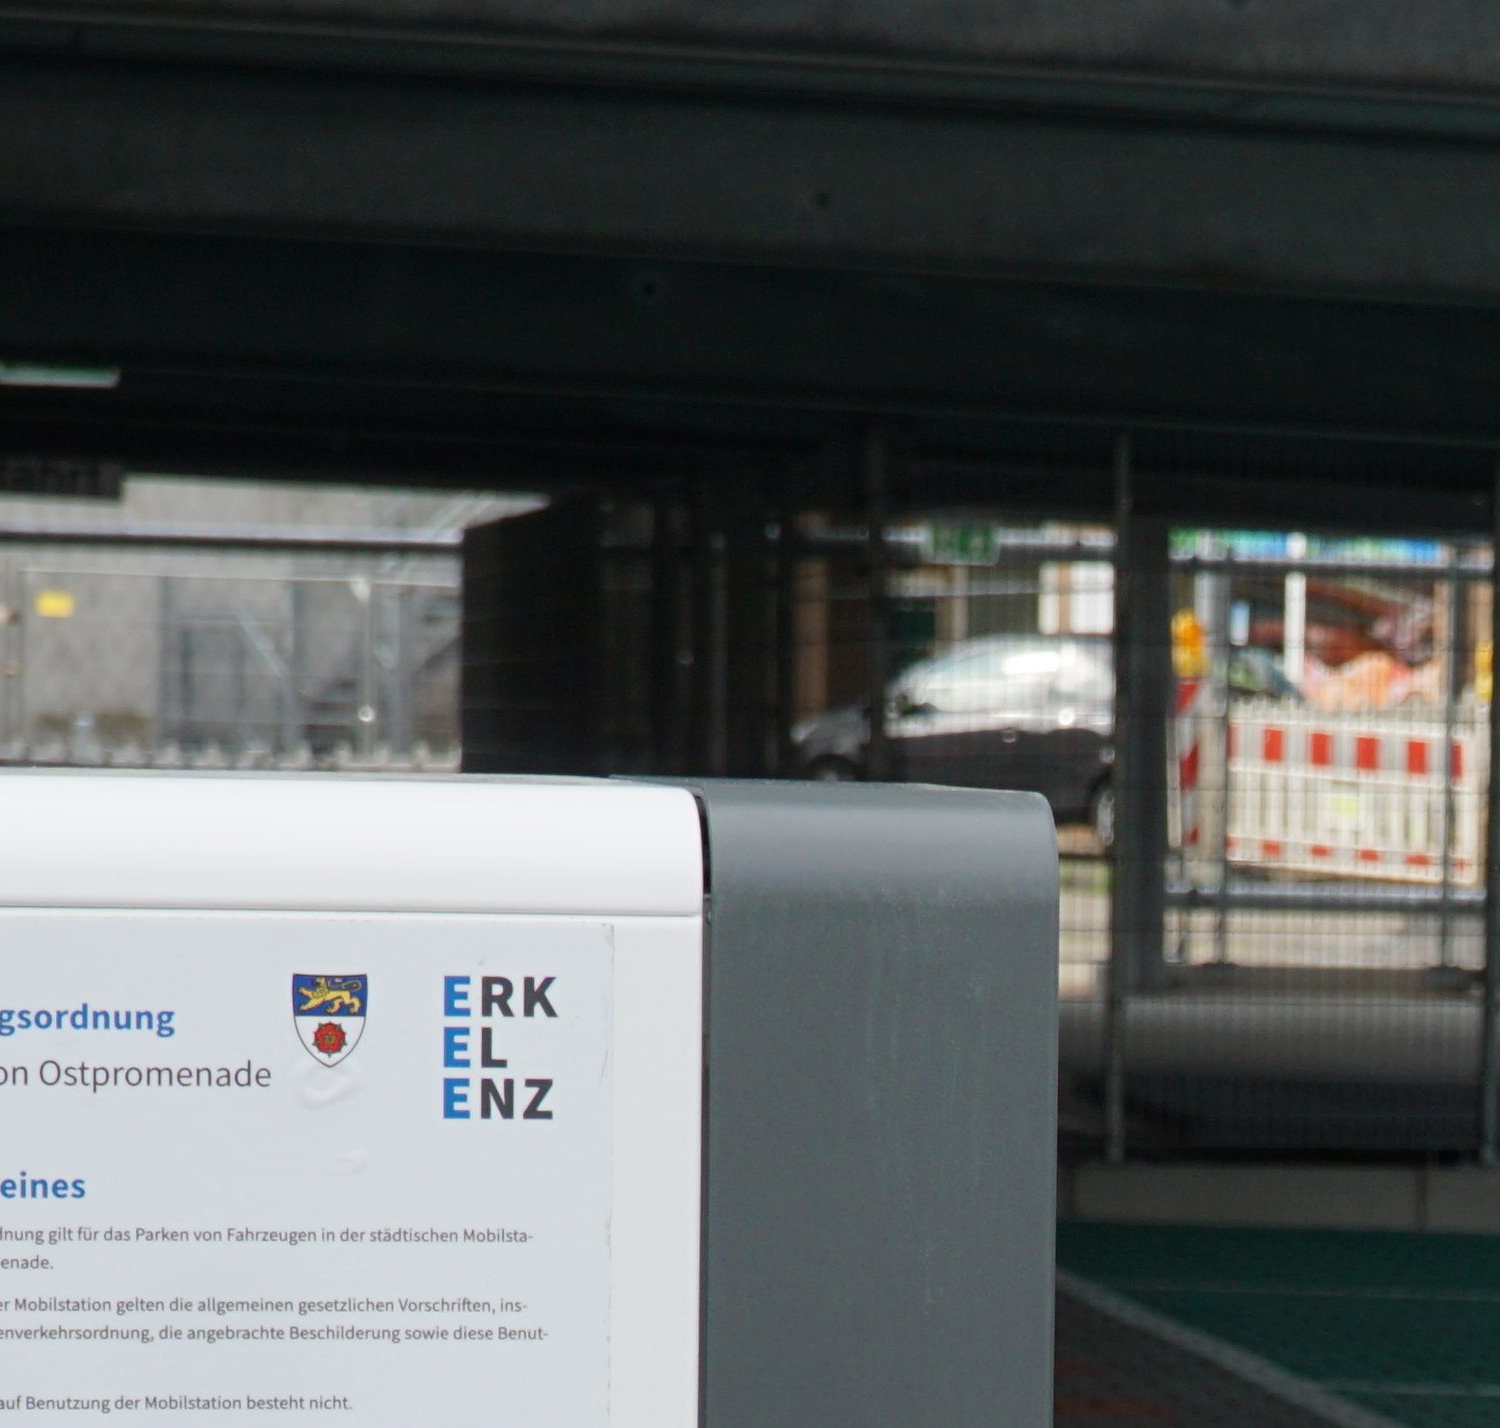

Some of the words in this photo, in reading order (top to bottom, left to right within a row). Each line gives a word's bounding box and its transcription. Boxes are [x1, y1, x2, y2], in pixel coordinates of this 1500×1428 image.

[444, 977, 557, 1019] ERK
[443, 1027, 508, 1070] EL
[38, 1060, 271, 1094] Ostpromenade
[443, 1078, 553, 1121] ENZ
[47, 1226, 73, 1246] gilt
[77, 1226, 100, 1242] für
[103, 1226, 131, 1242] das
[135, 1226, 189, 1242] Parken
[193, 1230, 222, 1242] von
[227, 1226, 316, 1246] Fahrzeugen
[321, 1227, 335, 1242] in
[339, 1228, 366, 1243] der
[369, 1228, 458, 1243] städtischen
[463, 1228, 532, 1243] Mobilsta-
[25, 1395, 111, 1414] Benutzung
[114, 1395, 141, 1410] der
[144, 1394, 241, 1410] Mobilstation
[246, 1394, 305, 1410] besteht
[309, 1395, 352, 1410] nicht.
